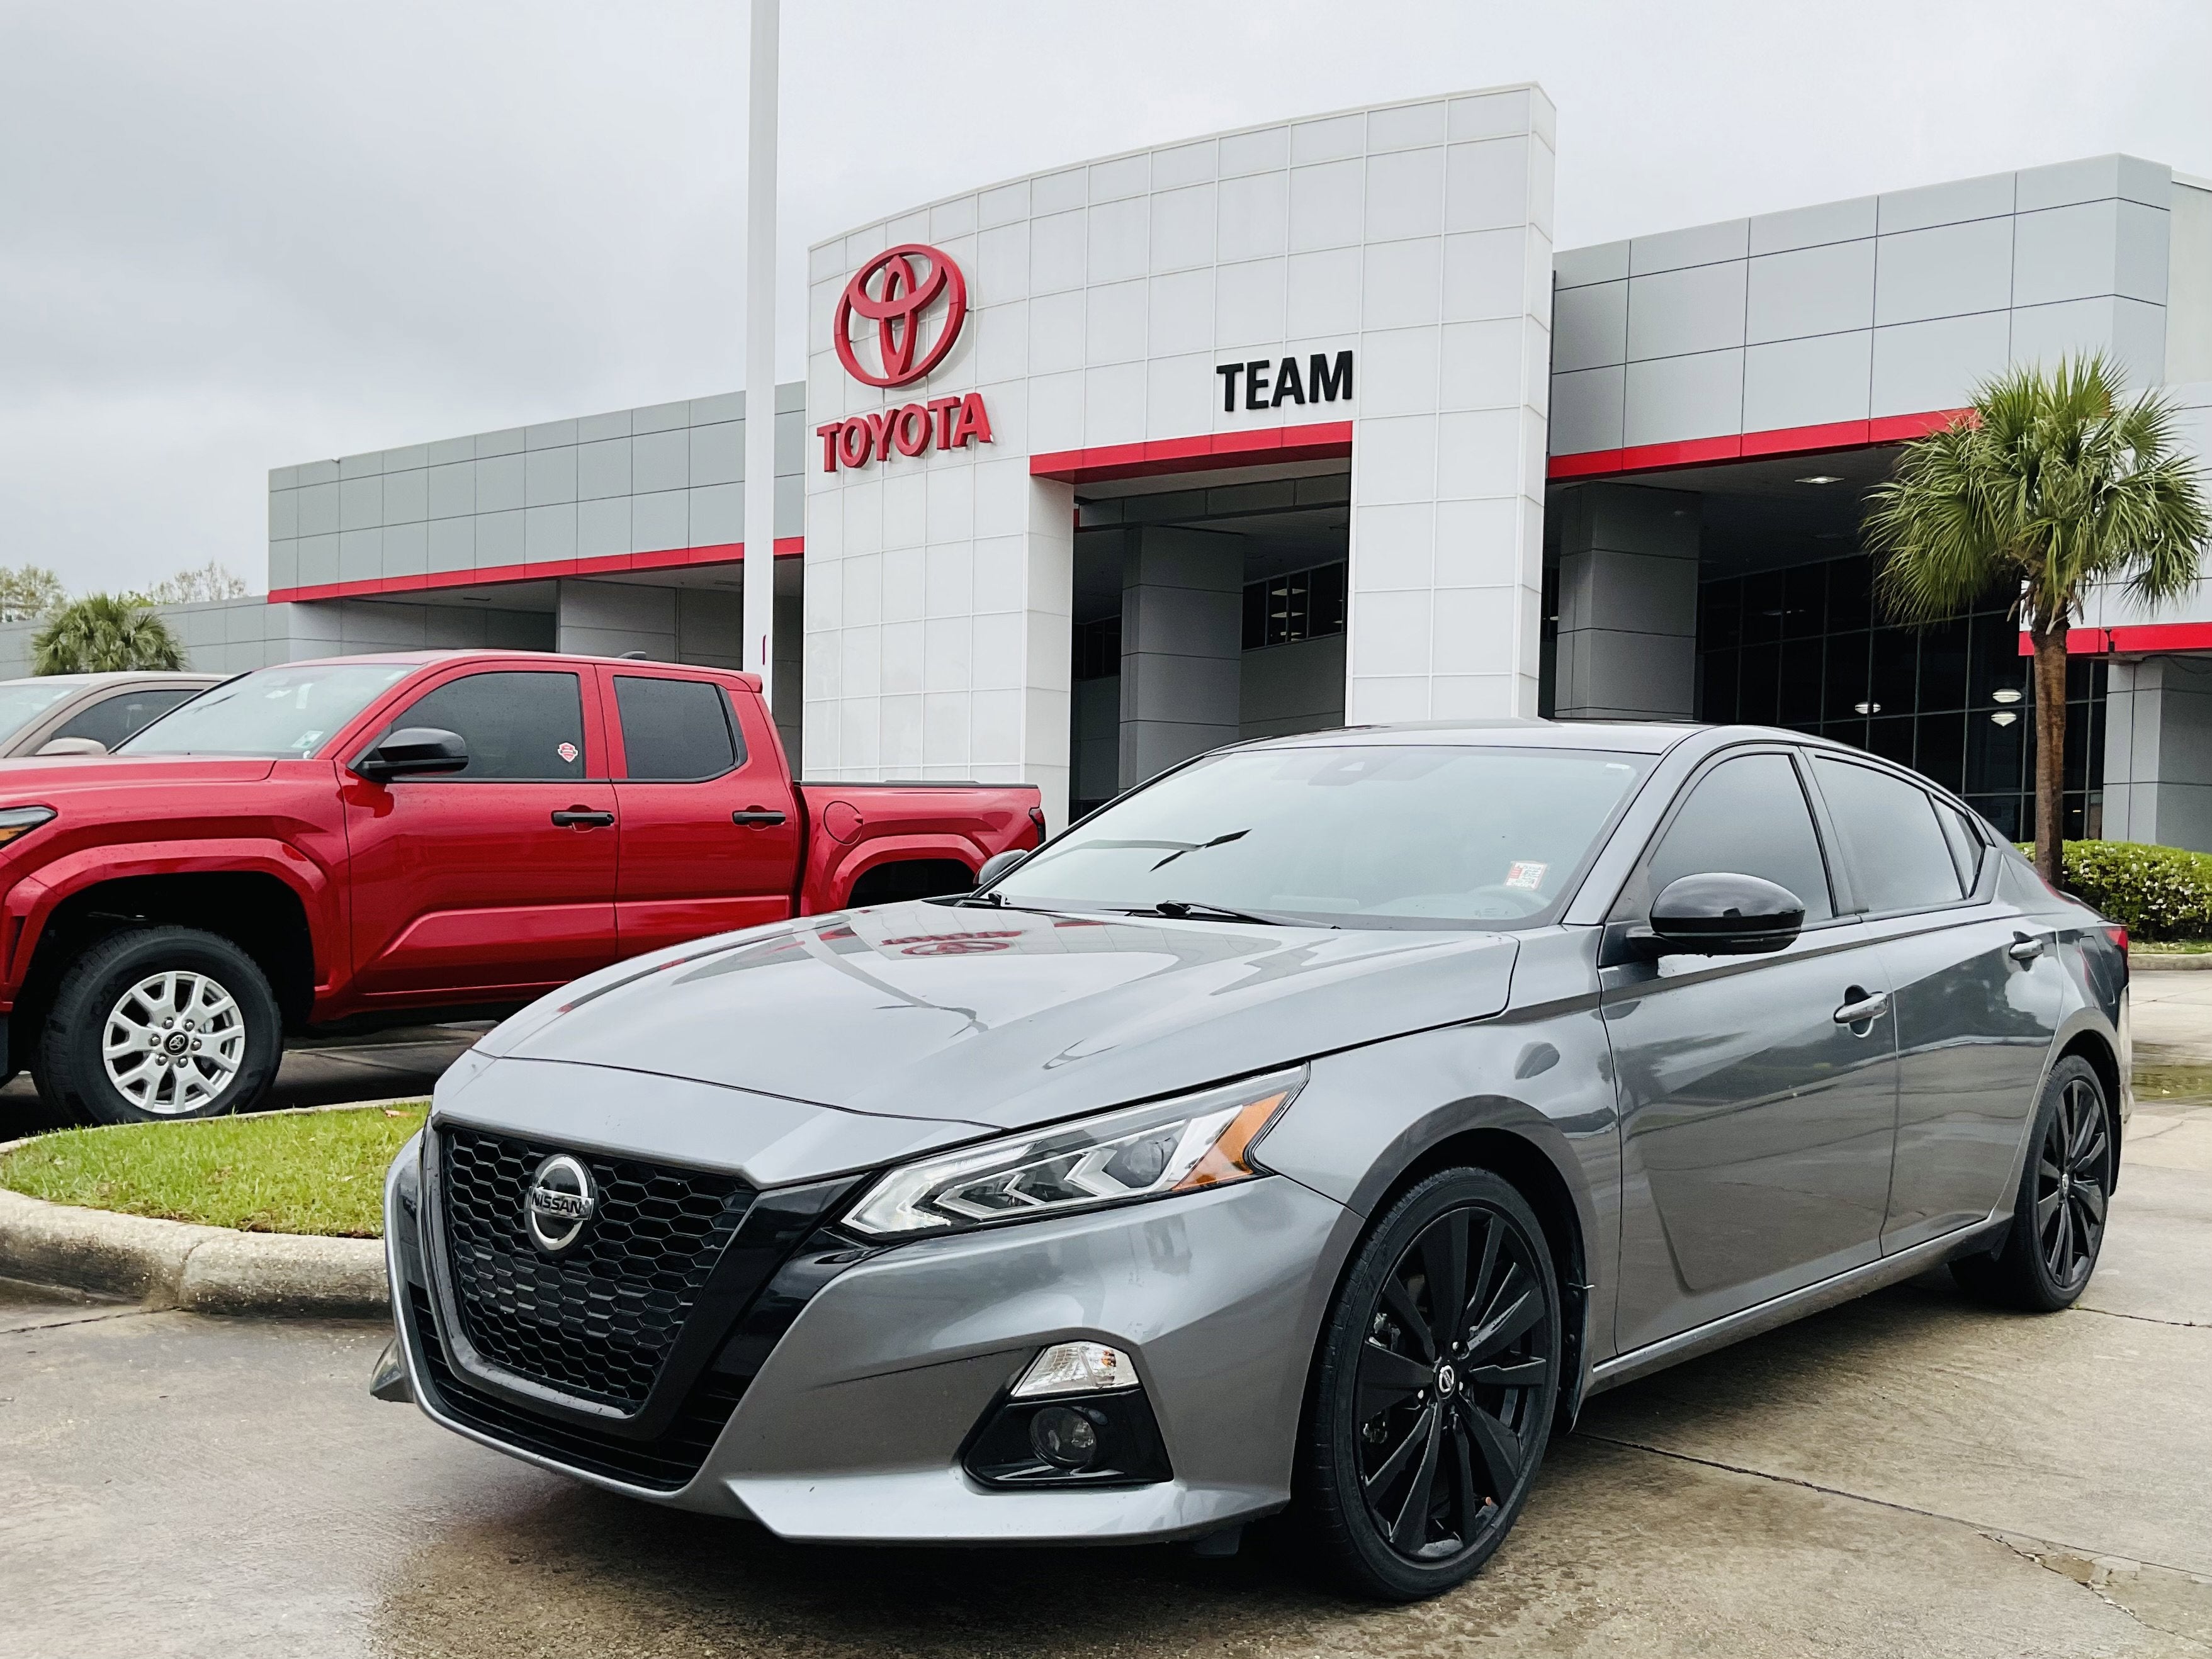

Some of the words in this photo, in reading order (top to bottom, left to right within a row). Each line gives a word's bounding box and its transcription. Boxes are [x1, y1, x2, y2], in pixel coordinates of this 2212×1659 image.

[1216, 350, 1353, 412] TEAM
[816, 392, 993, 473] TOYOTA
[532, 1193, 582, 1214] NISSAN
